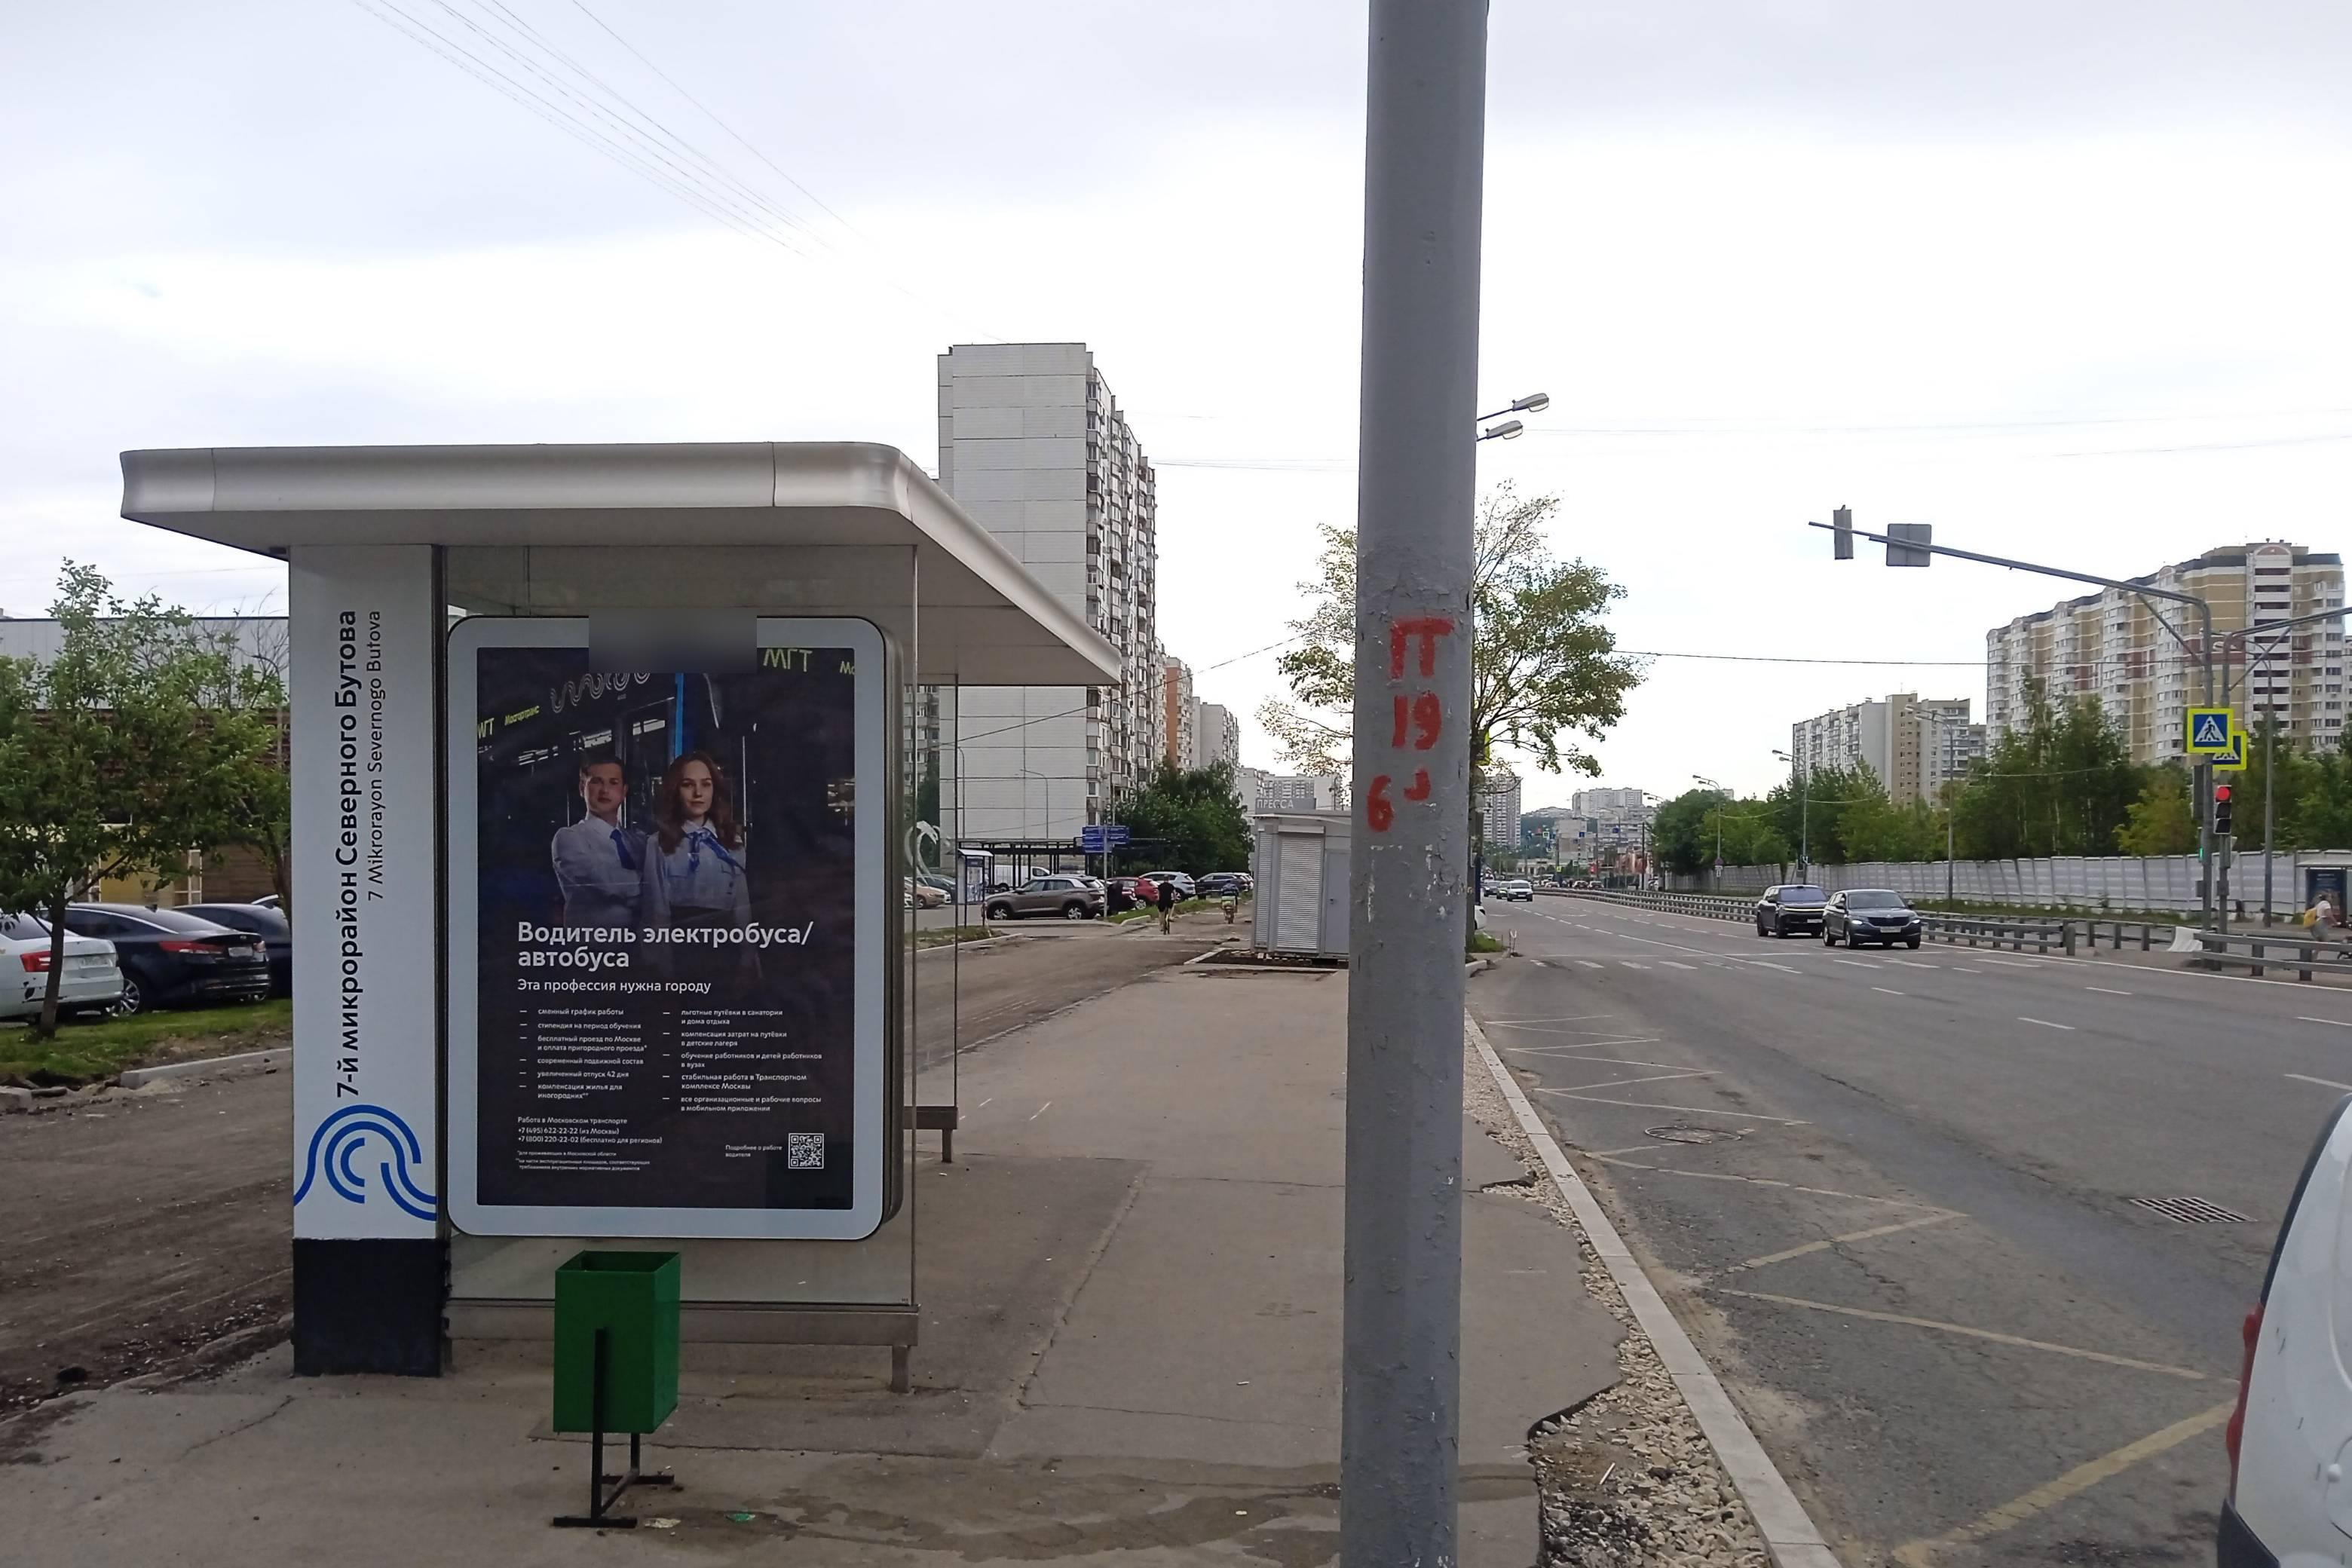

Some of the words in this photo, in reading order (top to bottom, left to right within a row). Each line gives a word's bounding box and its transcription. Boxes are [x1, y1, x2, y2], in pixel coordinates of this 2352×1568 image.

[335, 611, 362, 707] Бутова
[366, 610, 381, 672] Butova
[763, 648, 813, 672] МГТ
[367, 678, 386, 773] Severnogo
[1392, 689, 1442, 751] 19
[335, 715, 362, 865] Северного
[1257, 799, 1294, 809] ПРЕССА
[367, 779, 386, 884] Mikrorayon
[368, 890, 383, 901] 7
[518, 922, 636, 946] Водитель
[643, 921, 813, 948] электробуса/
[518, 947, 629, 972] автобуса
[335, 872, 363, 1051] микрорайон
[517, 979, 540, 990] Эта
[544, 979, 616, 993] профессия
[620, 983, 661, 991] нужна
[665, 983, 711, 994] городу
[336, 1057, 359, 1098] 7-й
